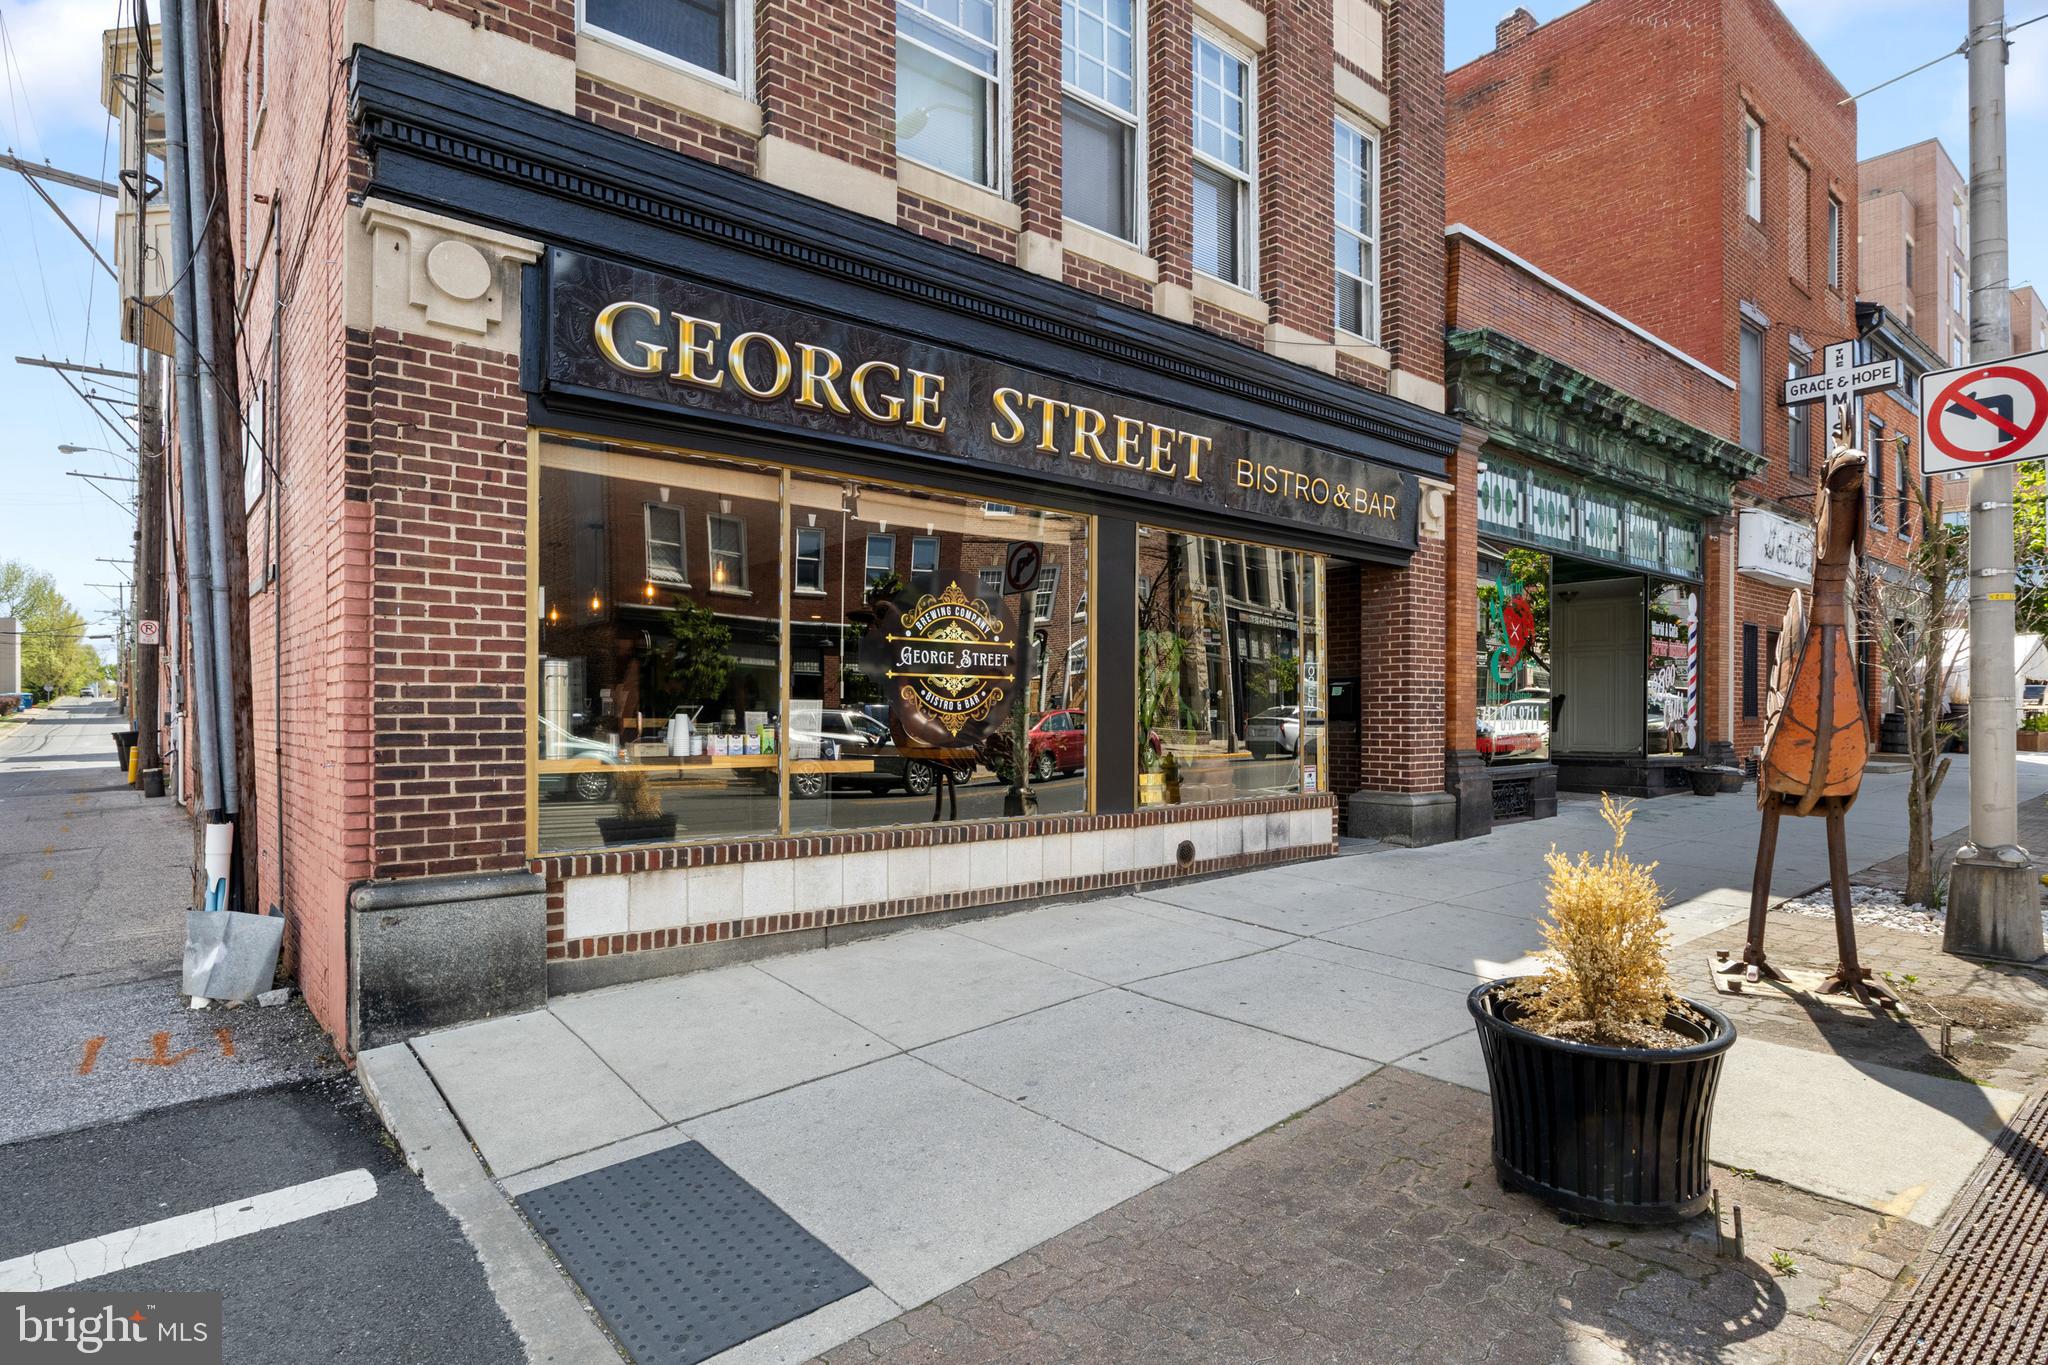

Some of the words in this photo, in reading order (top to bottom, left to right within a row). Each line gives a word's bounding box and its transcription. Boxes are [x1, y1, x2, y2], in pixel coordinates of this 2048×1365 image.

[1836, 348, 1844, 368] THE
[594, 301, 946, 434] GEORGE
[991, 387, 1212, 484] STREET
[1790, 378, 1834, 396] GRACE
[1837, 376, 1849, 388] &
[1852, 366, 1891, 386] HOPE
[915, 605, 953, 631] BREWING
[954, 606, 991, 635] COMPANY
[896, 646, 955, 667] GEORGE
[956, 648, 1009, 668] STREET
[924, 691, 954, 711] BISTRO
[957, 701, 963, 711] &
[964, 694, 981, 710] BAR
[1519, 705, 1540, 731] 8711
